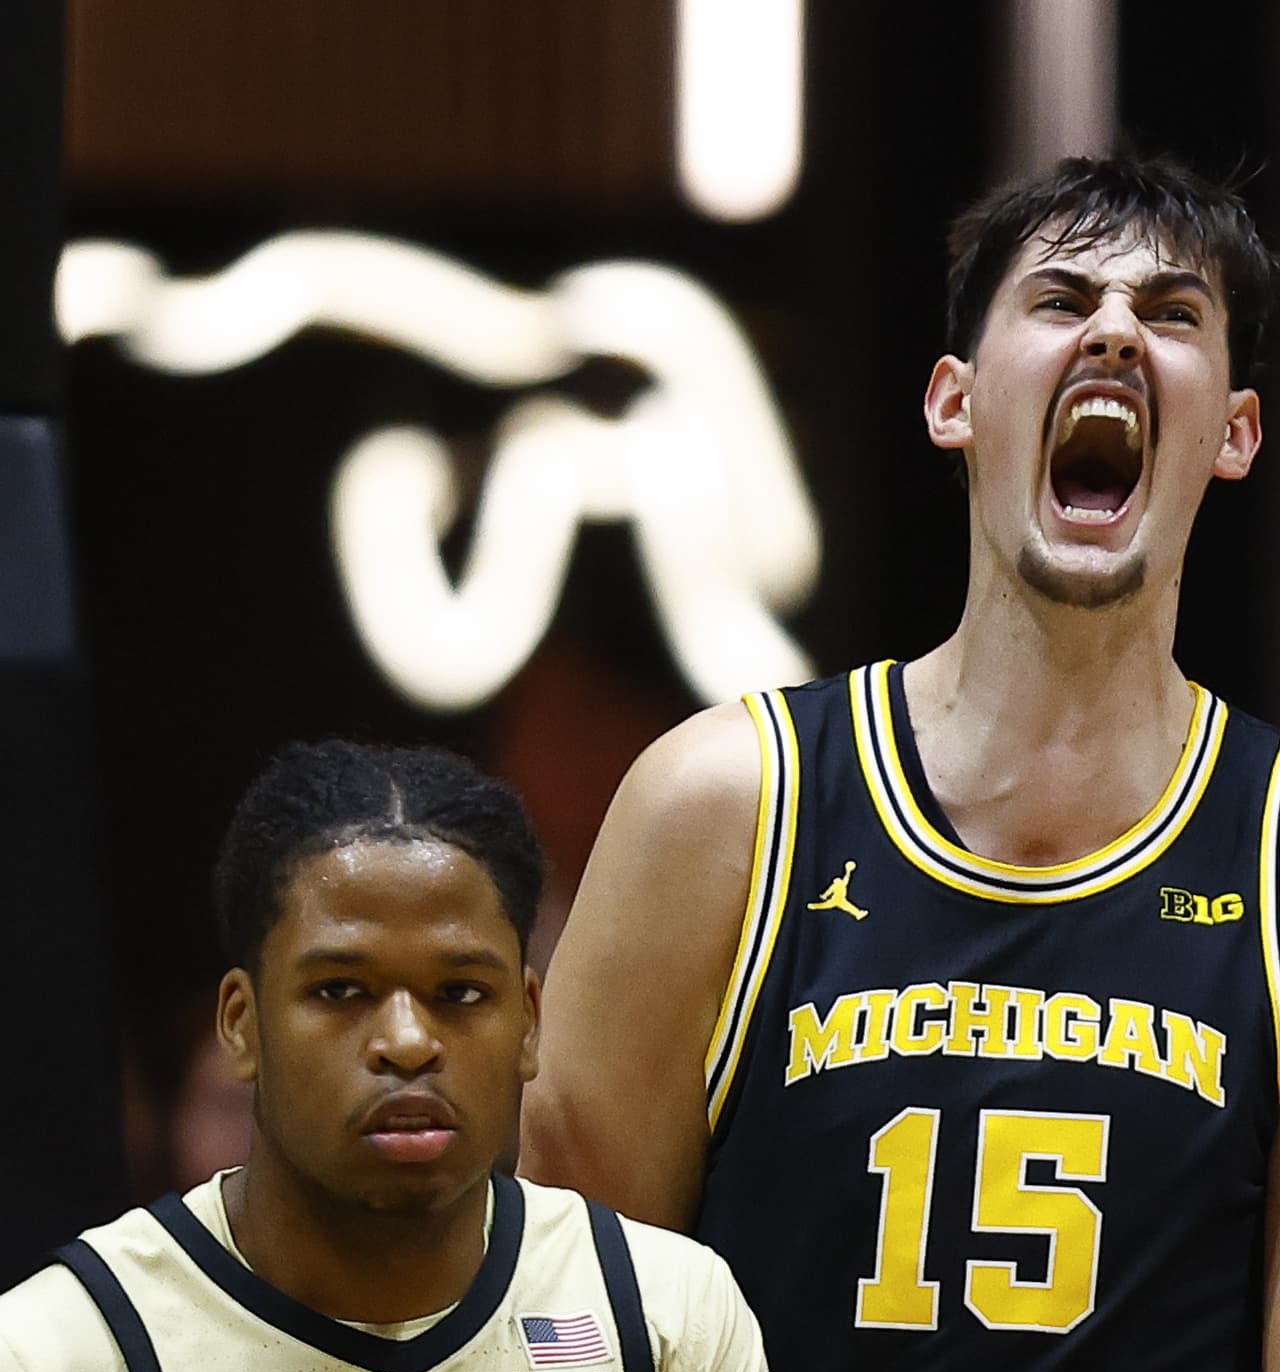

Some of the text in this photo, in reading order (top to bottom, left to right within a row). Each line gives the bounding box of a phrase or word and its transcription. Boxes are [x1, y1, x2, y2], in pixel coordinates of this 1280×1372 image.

[1159, 887, 1245, 925] BIG
[784, 980, 1227, 1108] MICHIGAN
[854, 1106, 1111, 1335] 15
